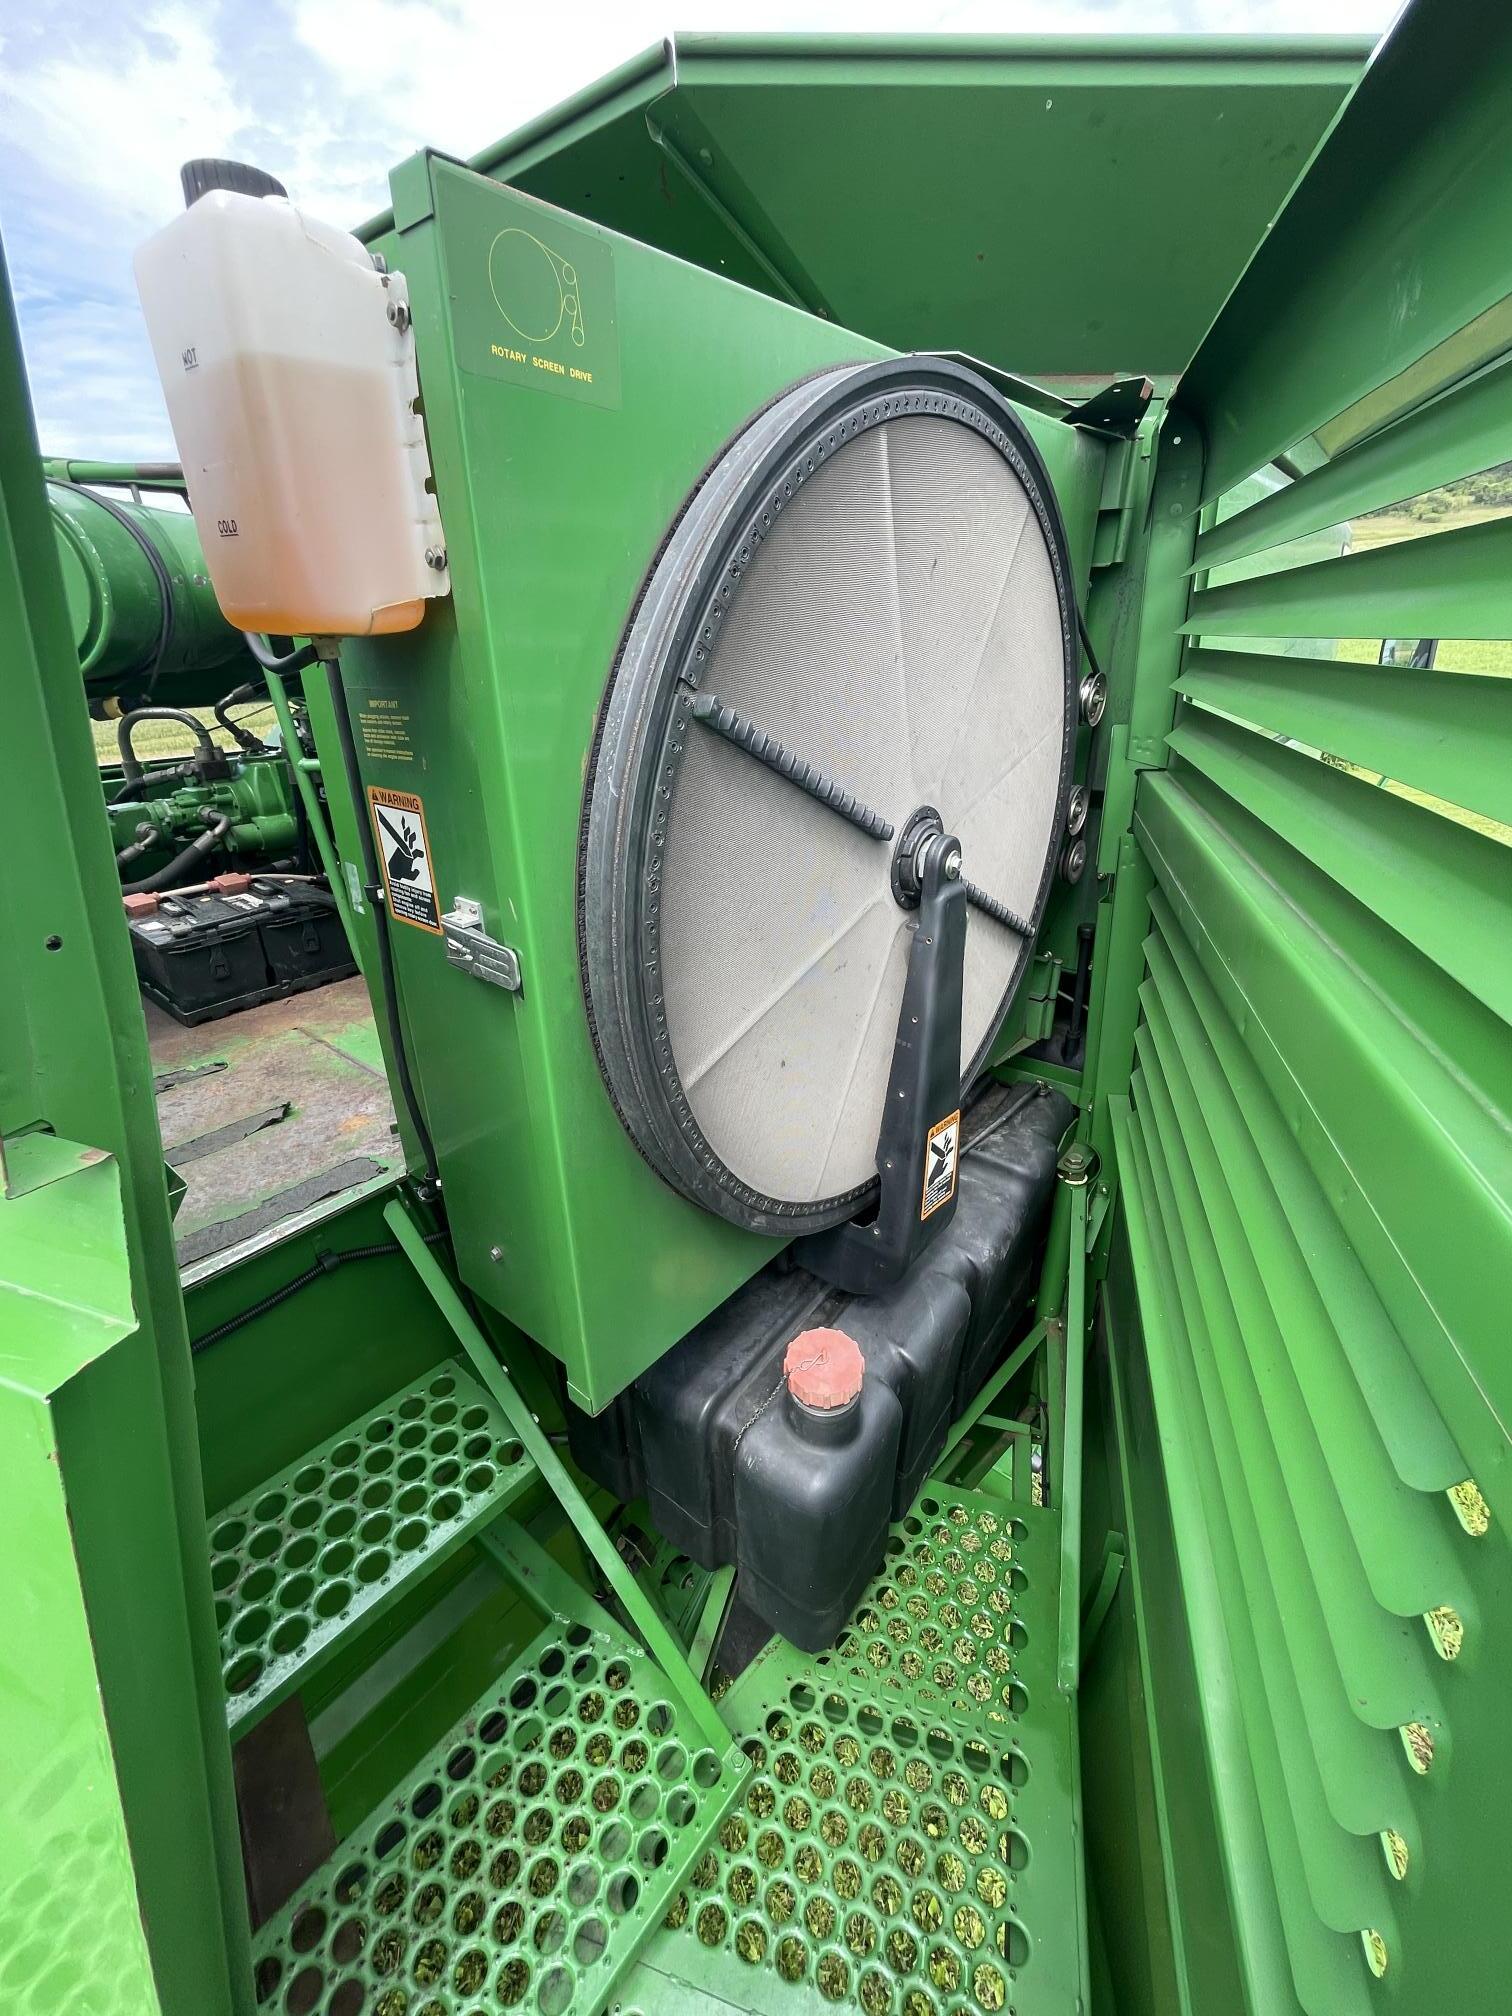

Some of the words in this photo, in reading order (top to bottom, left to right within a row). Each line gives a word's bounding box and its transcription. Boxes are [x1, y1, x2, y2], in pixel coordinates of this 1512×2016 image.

[491, 344, 527, 363] ROTARY
[532, 356, 565, 375] SCREEN
[570, 367, 593, 383] DRIVE
[217, 519, 238, 534] COLD
[379, 790, 419, 811] WARNING
